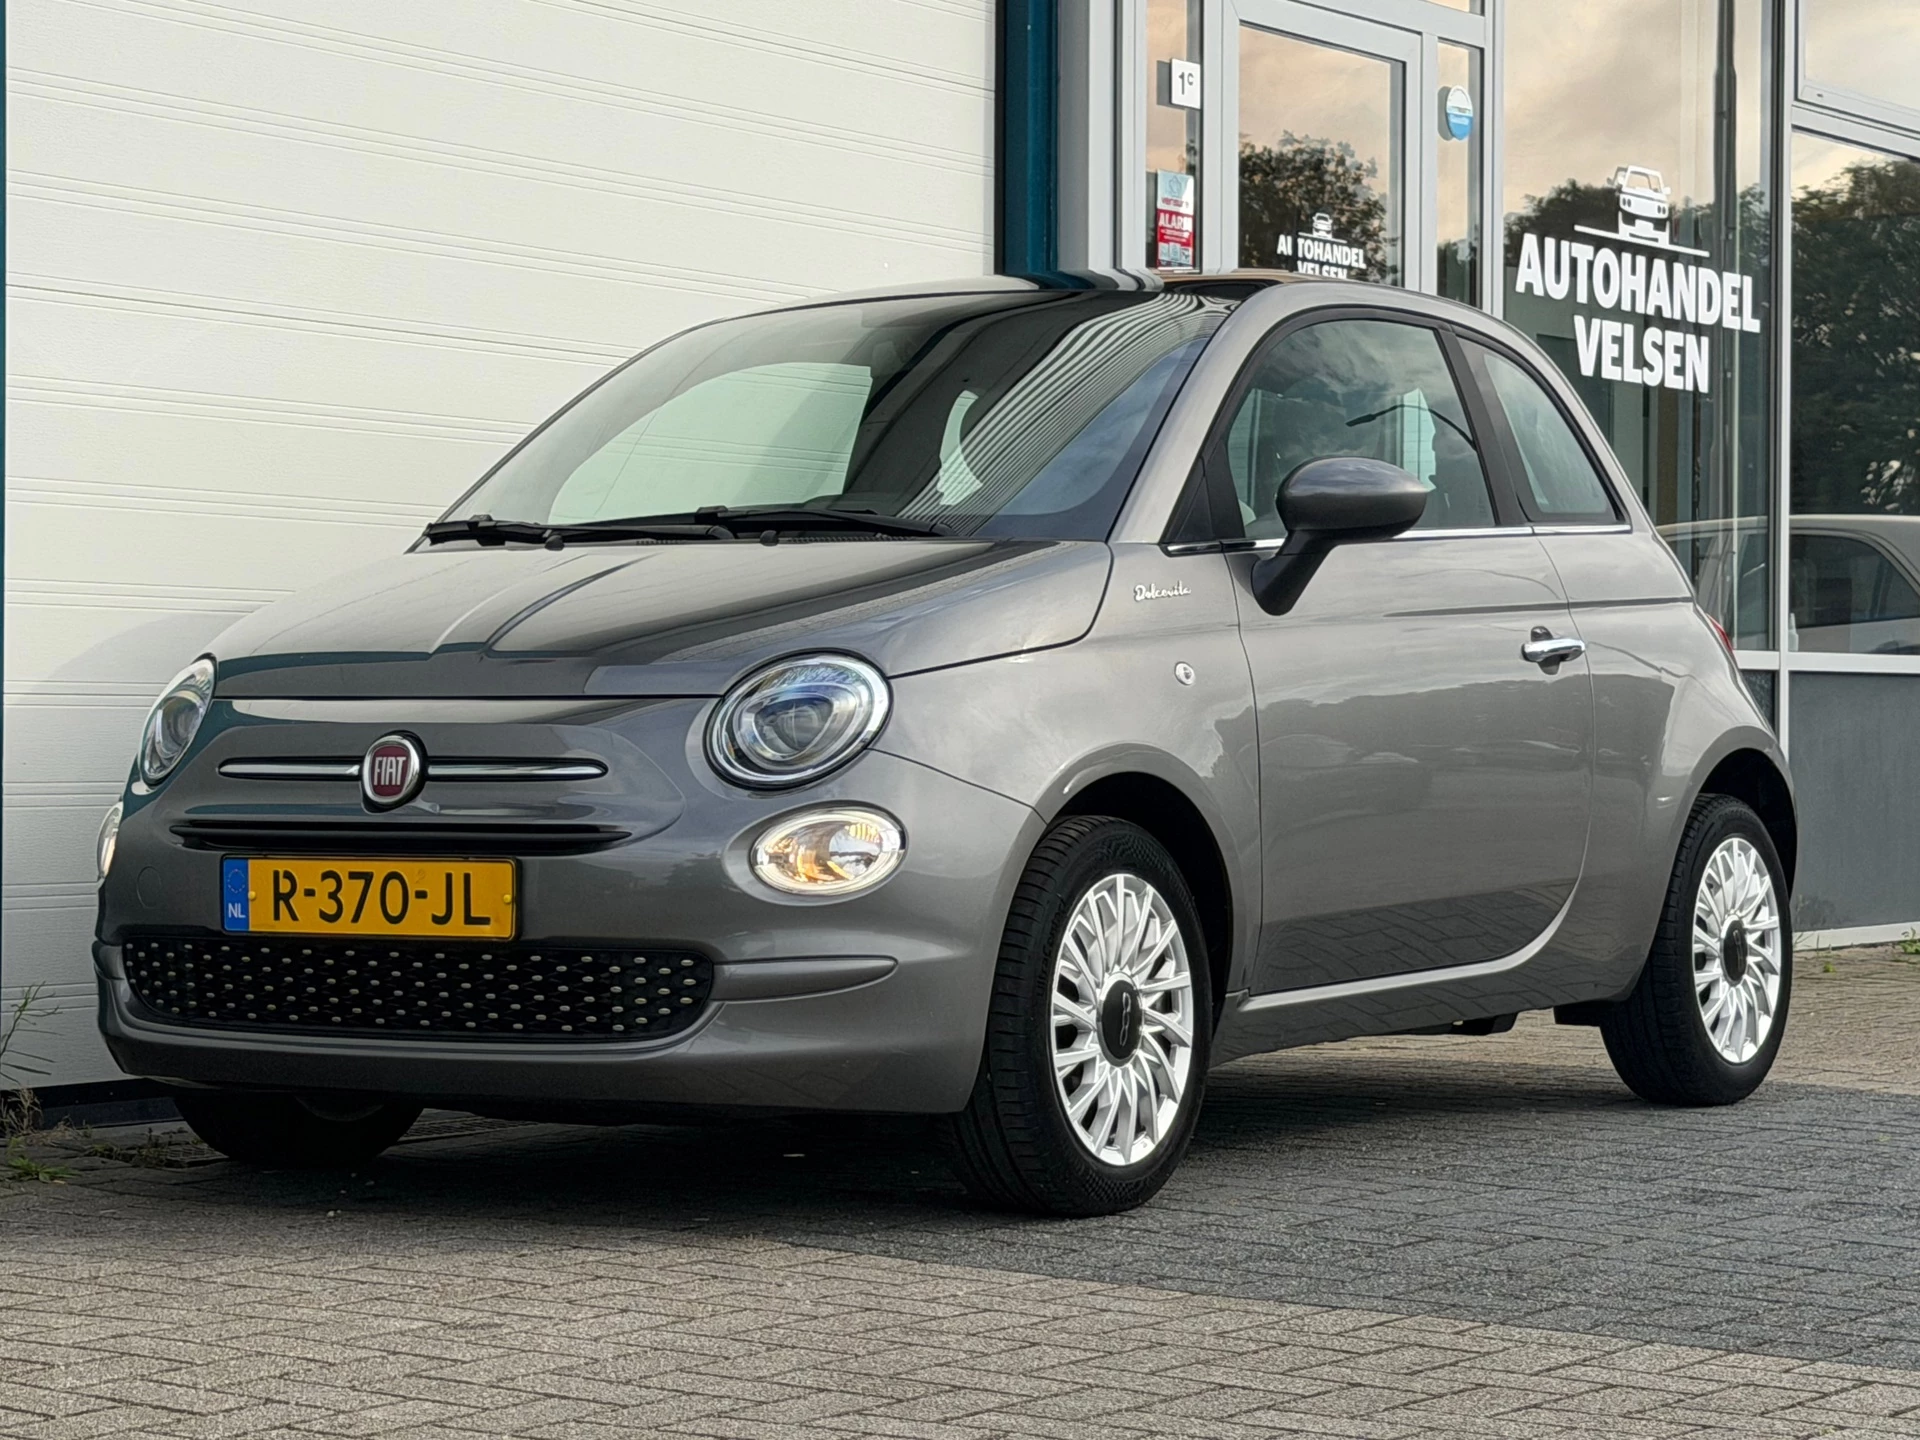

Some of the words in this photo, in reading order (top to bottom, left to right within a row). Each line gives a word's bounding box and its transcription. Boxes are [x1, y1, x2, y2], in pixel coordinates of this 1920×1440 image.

[1515, 233, 1761, 333] AUTOHANDEL
[1573, 315, 1709, 393] VELSEN
[373, 756, 407, 786] FIAT
[228, 902, 246, 918] NL
[272, 869, 491, 926] R-370-JL
